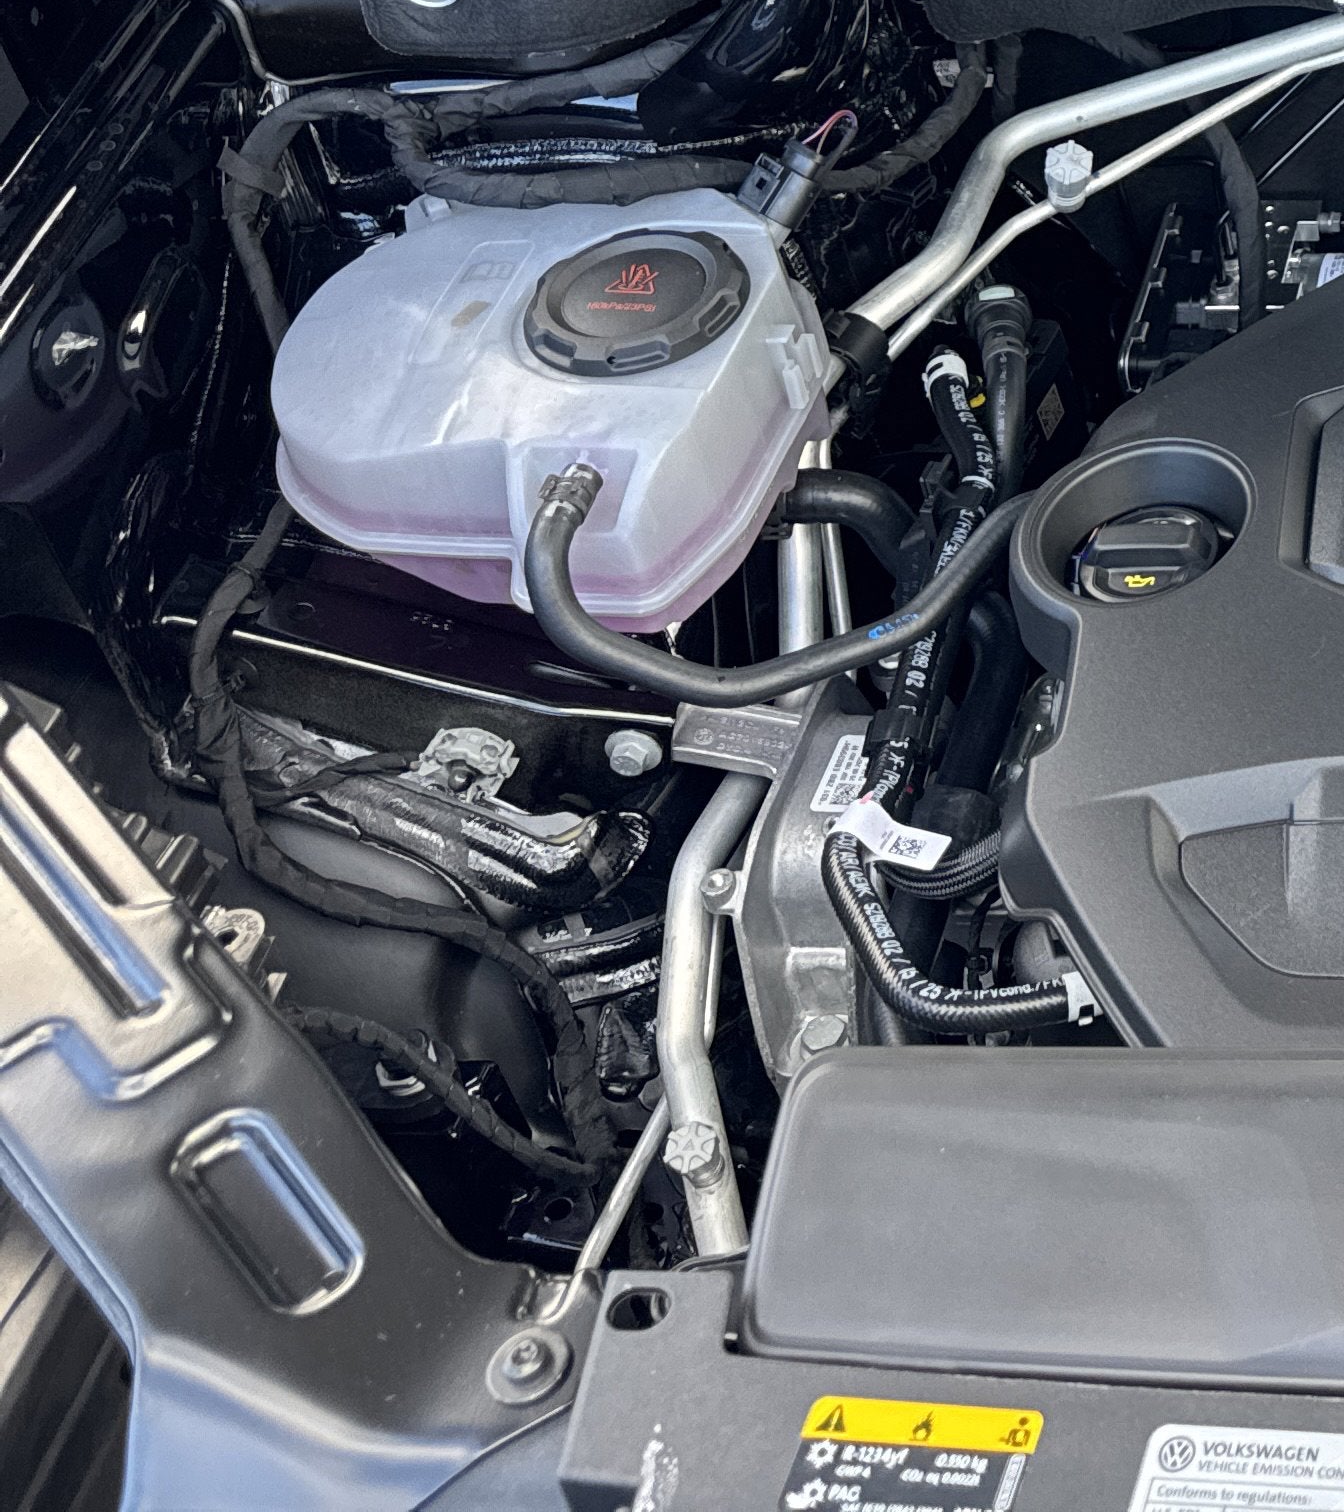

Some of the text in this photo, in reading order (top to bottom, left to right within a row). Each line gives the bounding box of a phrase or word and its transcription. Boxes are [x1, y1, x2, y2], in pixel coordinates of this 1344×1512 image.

[1203, 1440, 1320, 1462] VOLKSWAGEN
[1198, 1460, 1249, 1475] VEHICLE
[1252, 1463, 1314, 1479] EMISSION
[1157, 1484, 1218, 1500] Conforms
[1220, 1487, 1235, 1501] to
